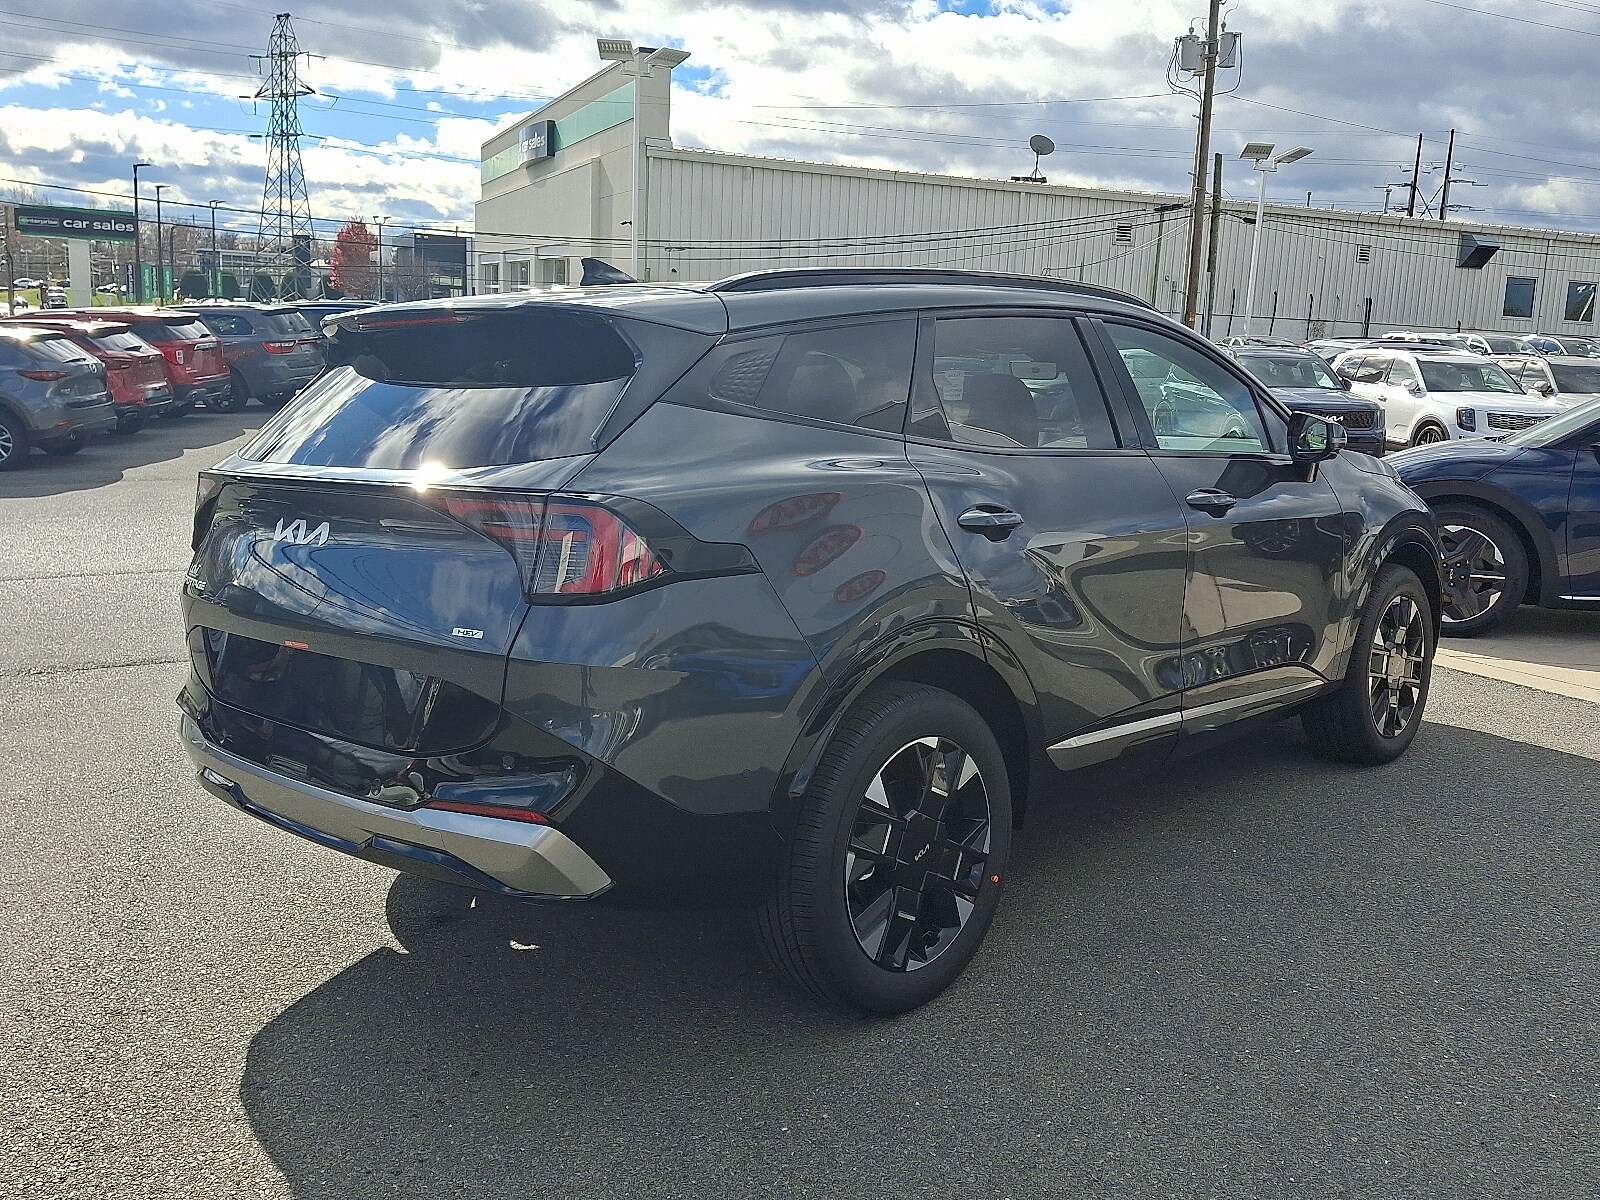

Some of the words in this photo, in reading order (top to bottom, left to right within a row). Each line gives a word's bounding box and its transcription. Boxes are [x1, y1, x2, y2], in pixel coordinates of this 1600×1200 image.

[529, 132, 545, 149] sales
[63, 219, 89, 229] car
[93, 219, 134, 232] sales
[274, 517, 330, 546] KIA
[456, 628, 481, 638] HEV
